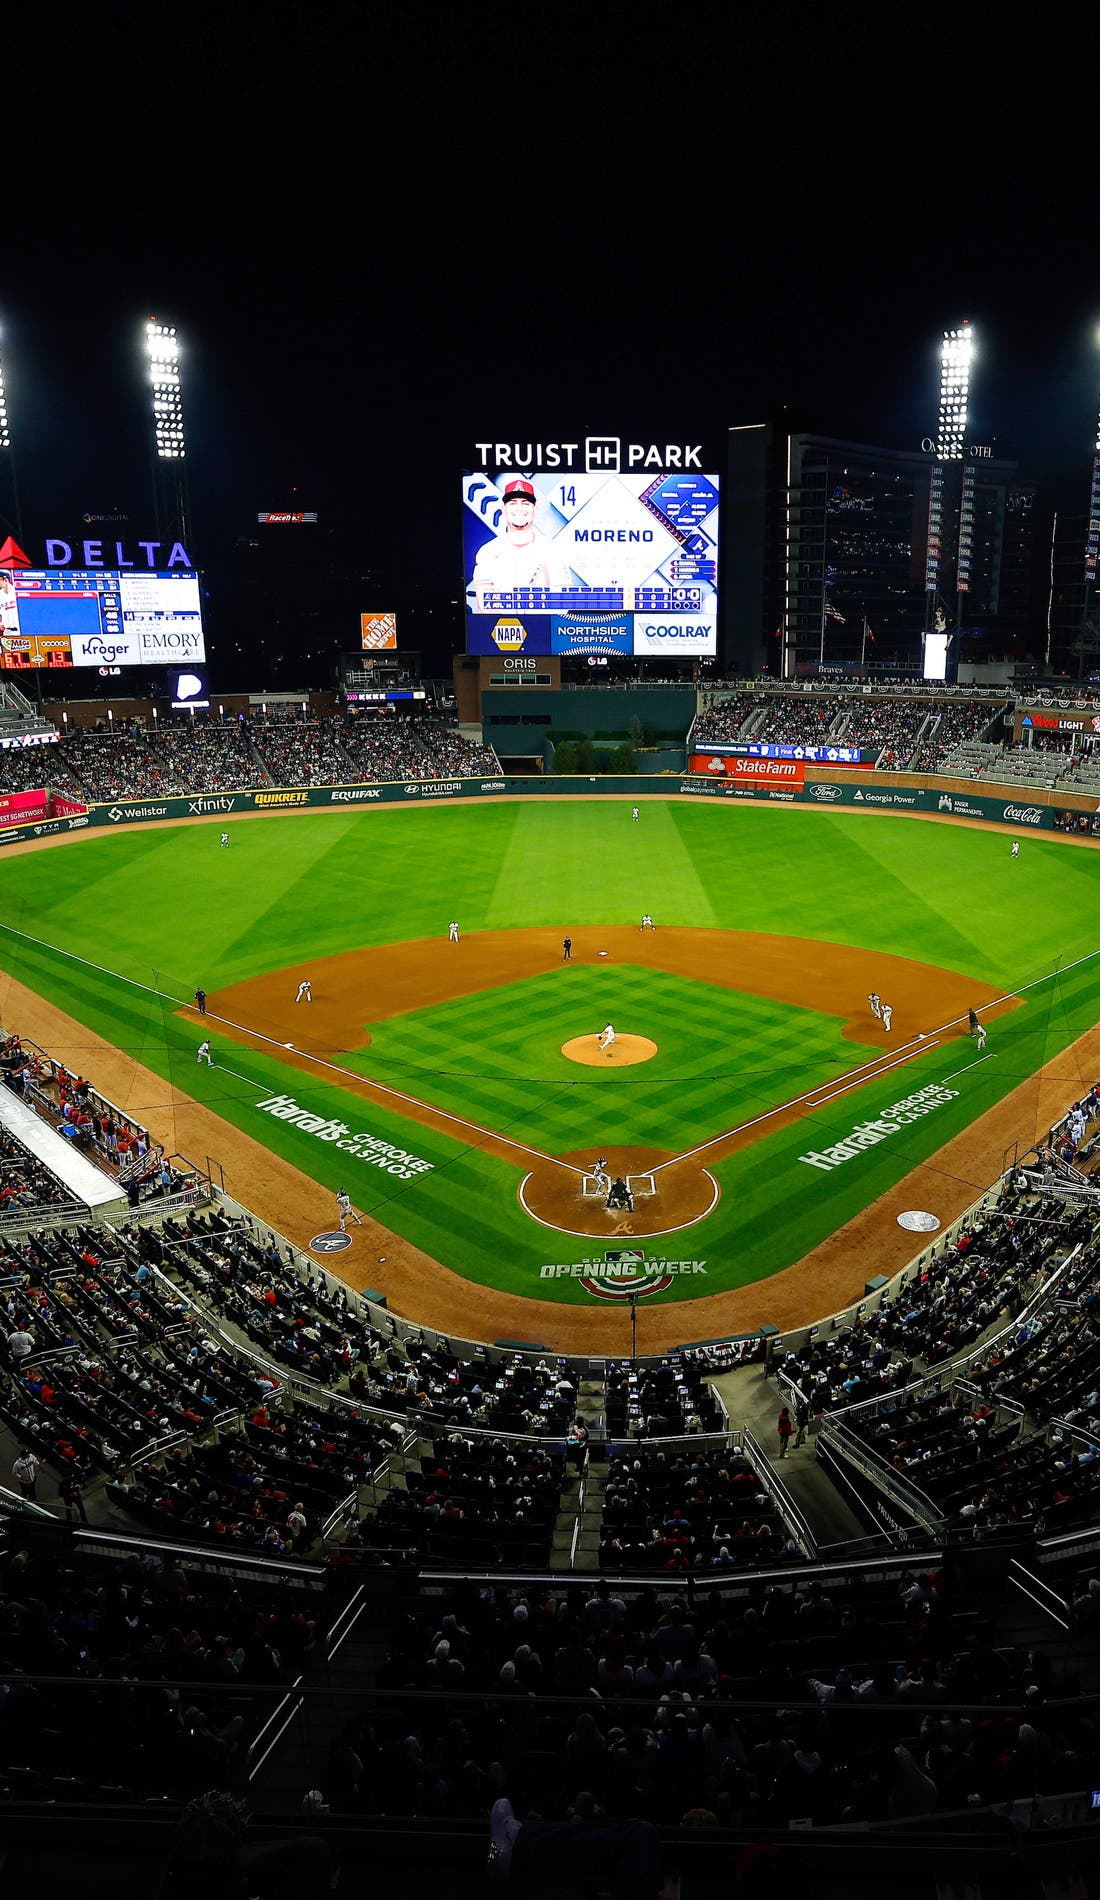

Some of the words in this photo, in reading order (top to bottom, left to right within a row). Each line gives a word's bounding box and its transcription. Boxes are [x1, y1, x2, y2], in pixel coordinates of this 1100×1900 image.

[475, 443, 579, 467] TRUIST
[628, 445, 703, 468] PARK
[965, 446, 994, 459] OTEL
[559, 485, 577, 507] 14
[574, 529, 654, 543] MORENO
[45, 539, 192, 567] DELTA
[362, 614, 396, 649] HOME
[497, 628, 523, 643] NAPA
[557, 626, 627, 636] NORTHSIDE
[645, 625, 713, 638] COOLRAY
[142, 633, 201, 648] EMORY
[570, 636, 615, 644] HOSPITAL
[82, 637, 130, 663] Kroger
[5, 653, 22, 664] 67
[504, 658, 536, 669] ORIS
[818, 665, 844, 674] Braves
[1058, 720, 1085, 730] LIGHT
[421, 783, 462, 792] HYUNDAI
[815, 785, 836, 797] Ford
[254, 792, 309, 804] QUIKRETE
[330, 790, 380, 801] EQUIFAX
[865, 793, 893, 803] Georgia
[893, 794, 916, 804] Power
[124, 805, 167, 818] Wellstar
[188, 797, 236, 815] xfinity
[879, 1083, 946, 1119] CHEROKEE
[896, 1088, 961, 1125] CASINOS
[335, 1139, 418, 1180] CASINOS
[352, 1132, 436, 1174] CHEROKEE
[539, 1262, 638, 1279] OPENING
[643, 1260, 708, 1276] WEEK
